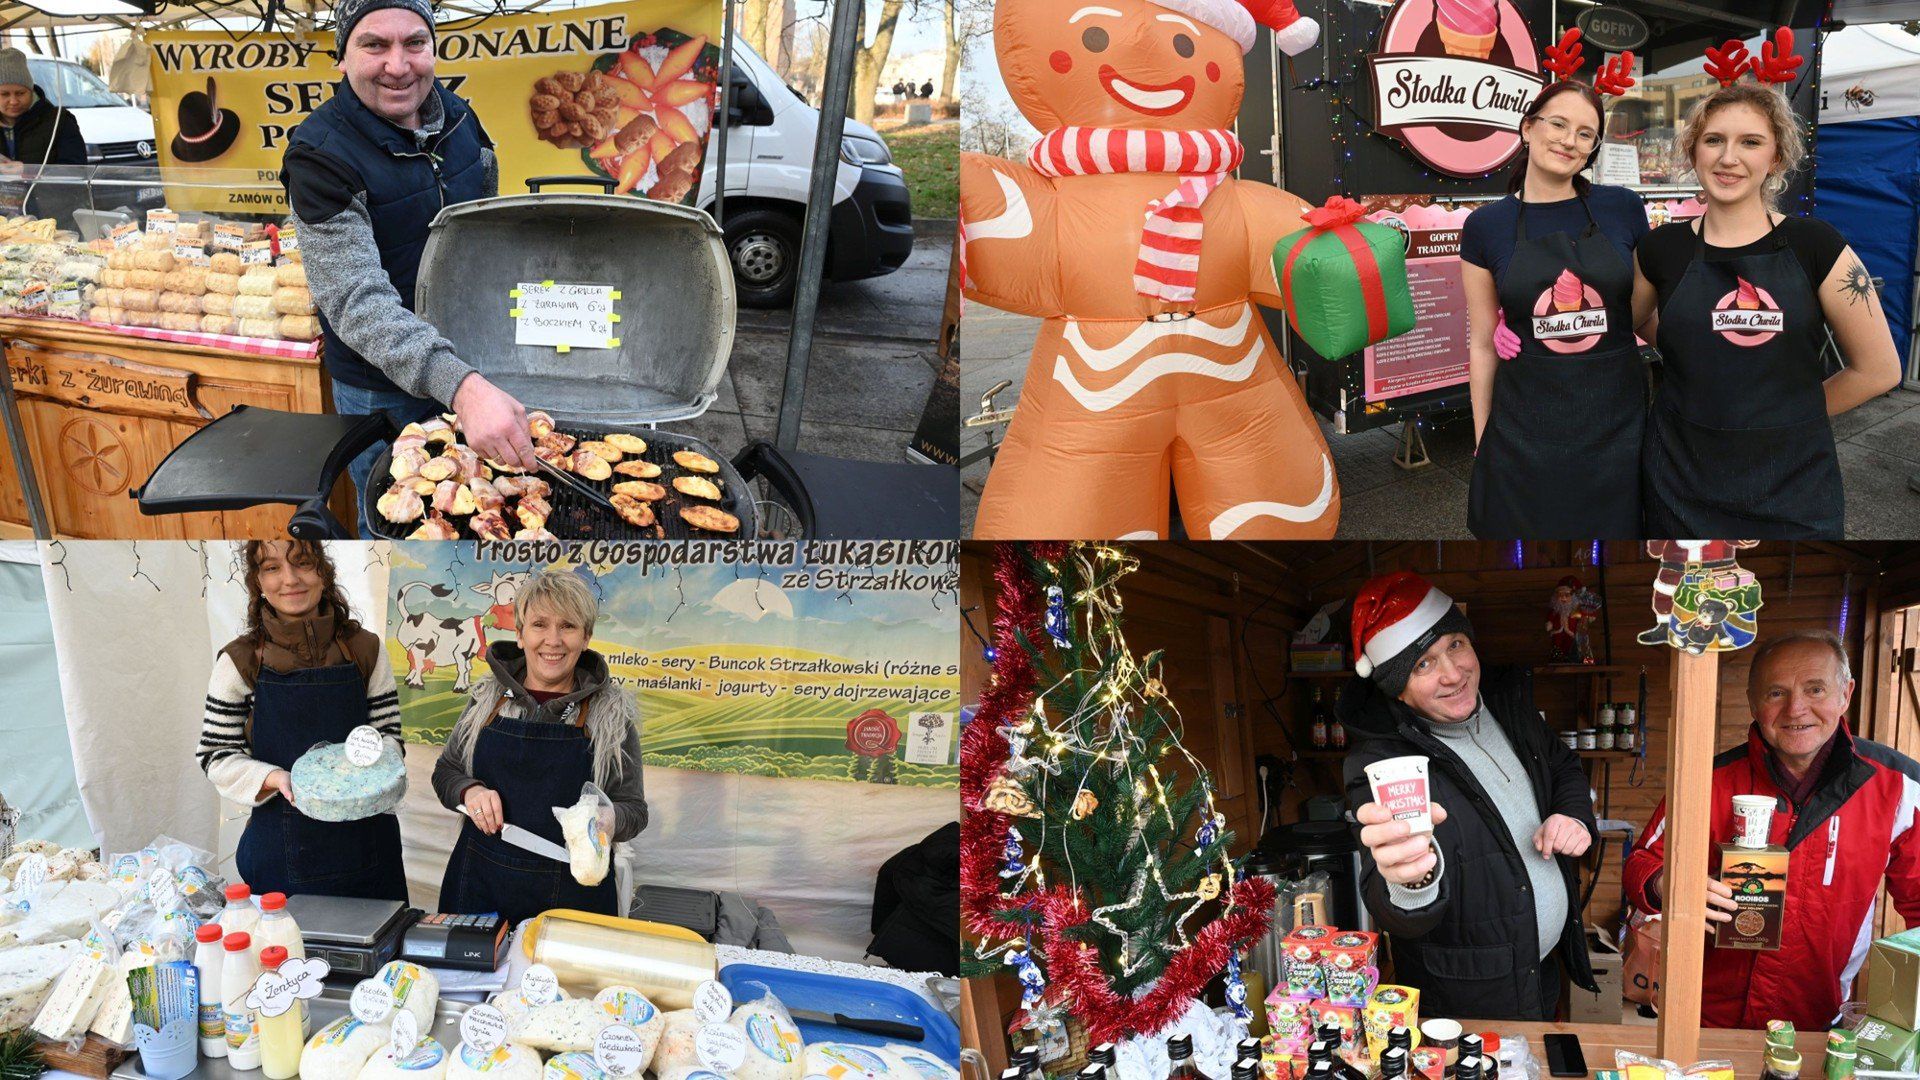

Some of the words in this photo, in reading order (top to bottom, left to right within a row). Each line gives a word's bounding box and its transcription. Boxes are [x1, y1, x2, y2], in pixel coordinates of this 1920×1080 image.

[1591, 19, 1636, 36] GOFRY
[153, 42, 315, 71] WYROBY
[1387, 68, 1467, 109] Słodka
[229, 192, 272, 205] ZAMÓW
[1429, 233, 1459, 242] GOFRY
[1417, 244, 1461, 254] TRADYCYJ
[1572, 315, 1605, 331] Chwila
[1748, 313, 1781, 328] Chwila
[59, 370, 76, 388] z
[86, 369, 190, 408] żurawiną
[476, 541, 562, 563] Prosto
[568, 544, 582, 564] z
[589, 541, 795, 576] Gospodarstwa
[782, 573, 809, 589] ze
[608, 652, 648, 666] mleko
[661, 657, 695, 671] sery
[709, 655, 765, 670] Buncok
[770, 657, 879, 674] Strzałkowski
[884, 660, 941, 679] (różne
[637, 676, 702, 691] maślanki
[715, 679, 777, 697] jogurty
[794, 685, 831, 699] sery
[833, 683, 951, 704] dojrzewające
[1388, 782, 1416, 797] MERRY
[1734, 895, 1769, 903] ROOIBOS
[265, 971, 311, 999] Żentyca
